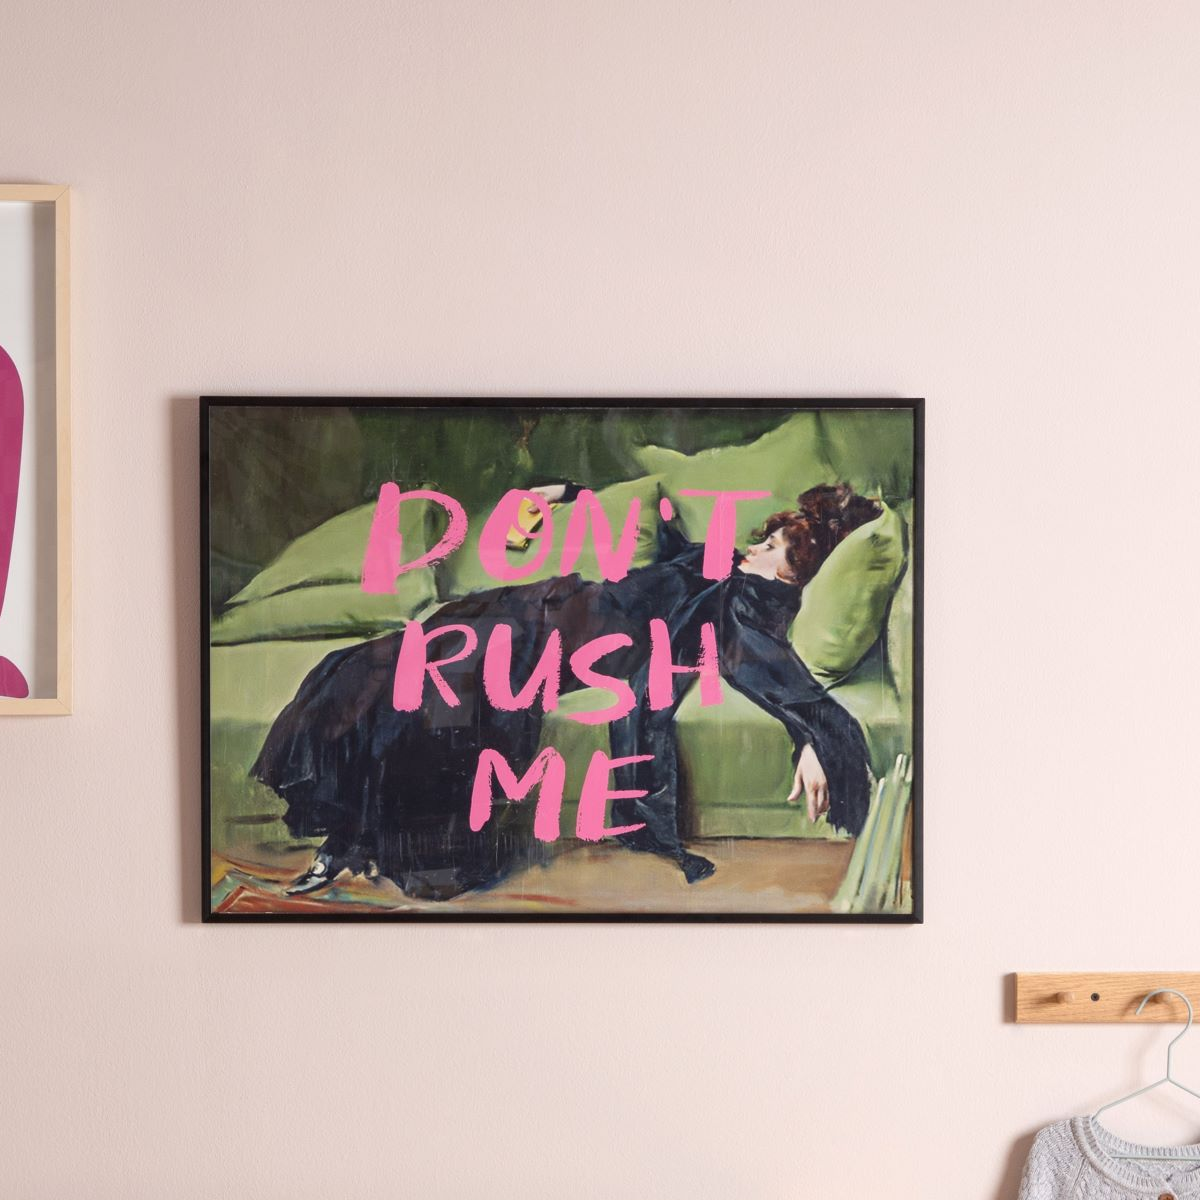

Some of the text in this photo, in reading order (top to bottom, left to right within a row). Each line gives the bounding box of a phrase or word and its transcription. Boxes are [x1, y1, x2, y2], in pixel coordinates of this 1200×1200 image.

[361, 482, 772, 594] DON'T
[393, 618, 724, 726] RUSH
[469, 747, 655, 842] ME
